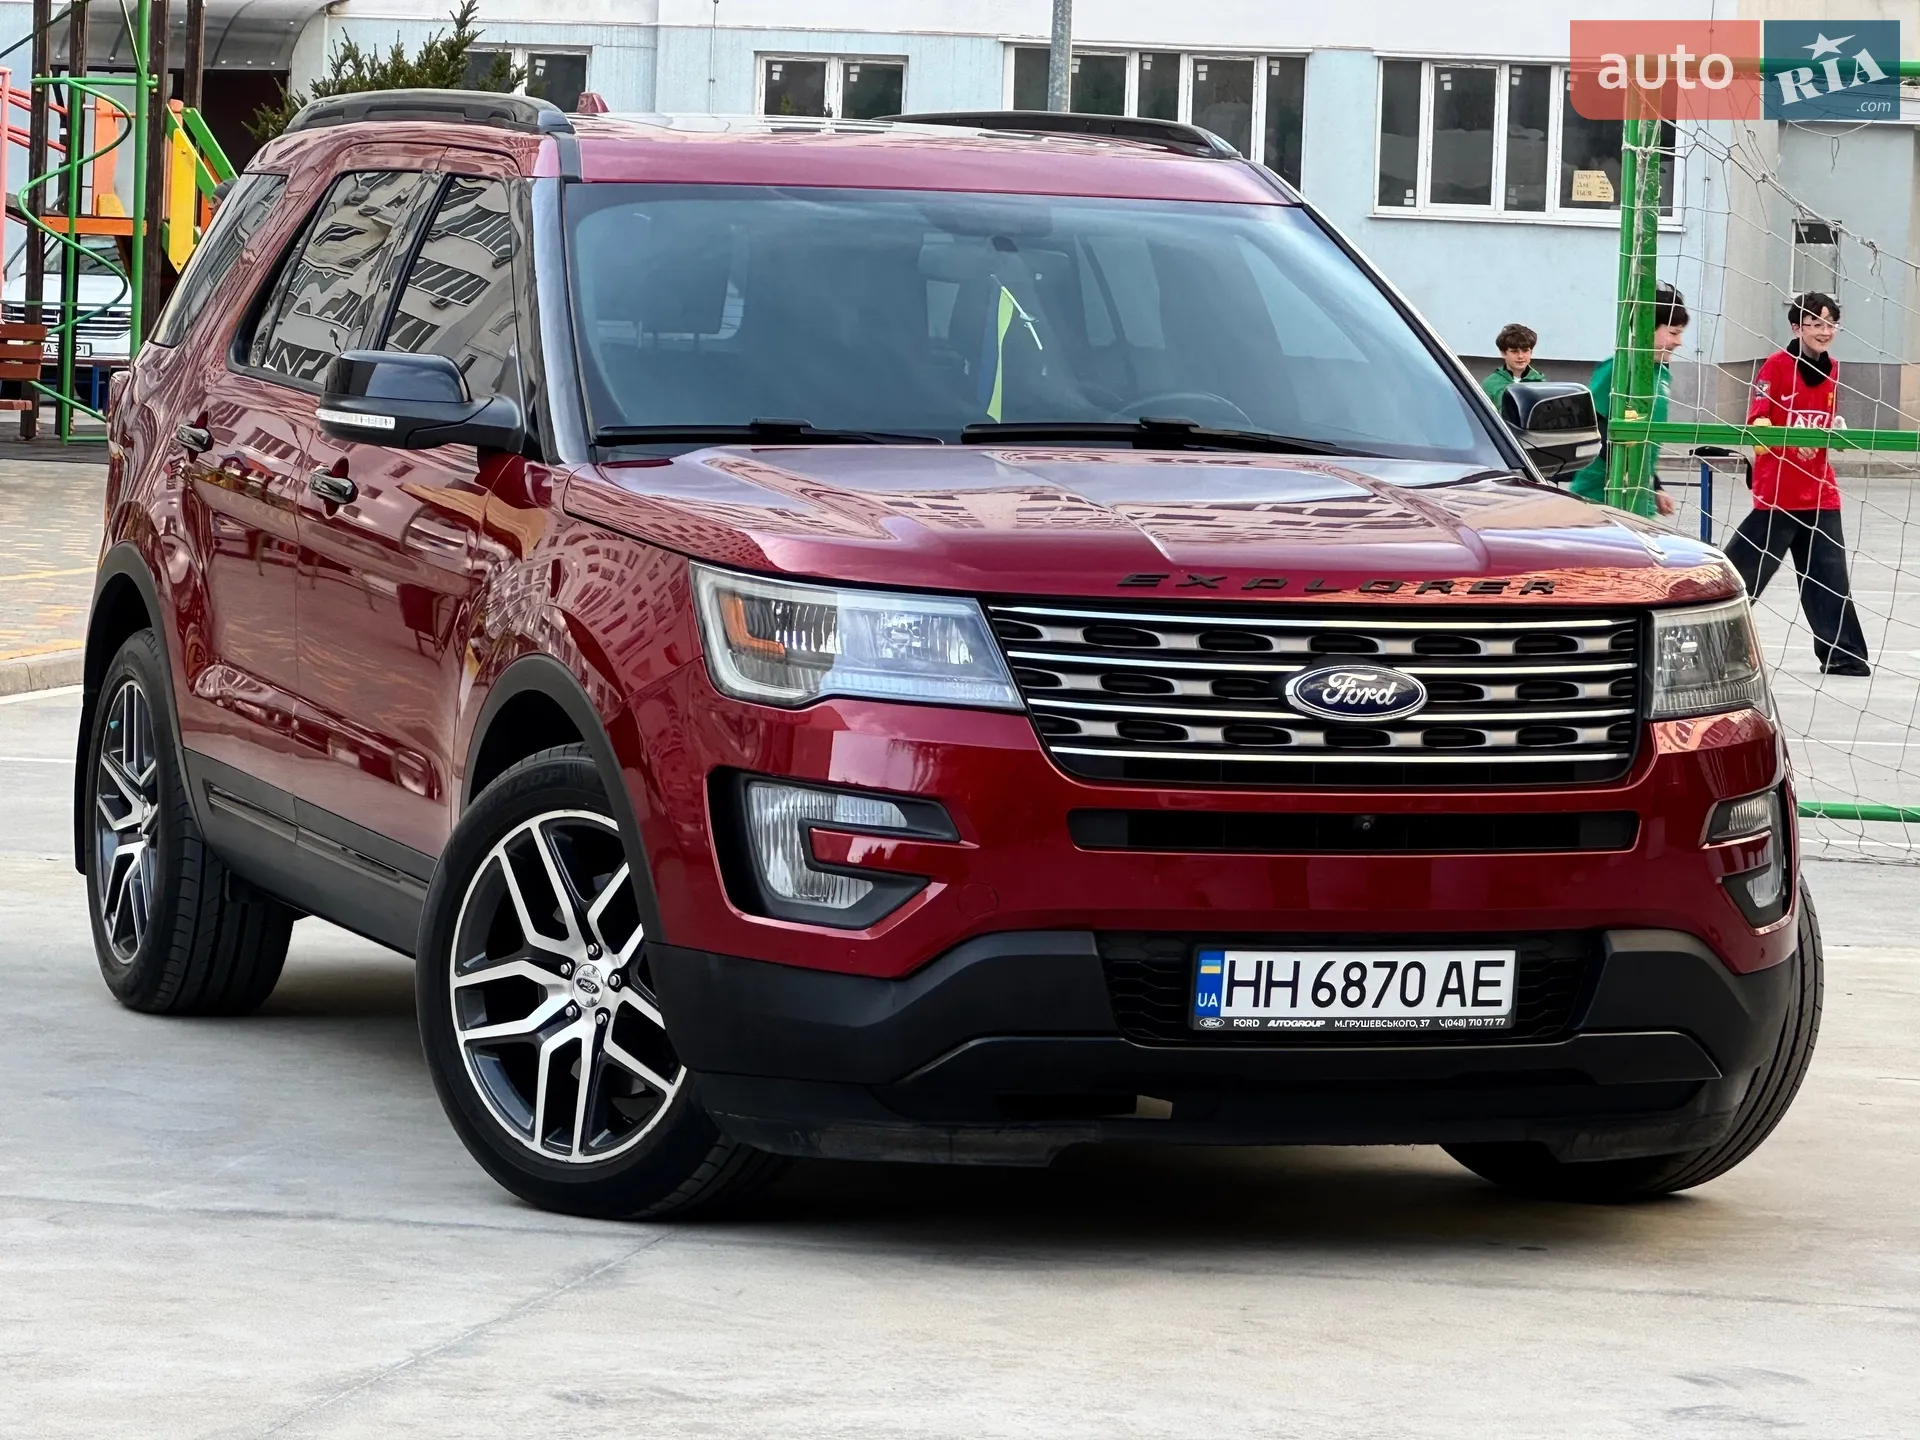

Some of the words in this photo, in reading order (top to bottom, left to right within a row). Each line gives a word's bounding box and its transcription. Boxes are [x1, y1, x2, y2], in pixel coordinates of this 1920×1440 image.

[1116, 572, 1556, 595] EXPLORER
[1322, 672, 1398, 706] Ford
[1225, 960, 1301, 1008] HH
[1311, 960, 1427, 1008] 6870
[1436, 960, 1505, 1007] AE
[1197, 992, 1218, 1008] UA
[1233, 1018, 1260, 1027] FORD
[1267, 1019, 1326, 1027] AUTOGROUP
[1419, 1019, 1430, 1027] 37
[1445, 1018, 1467, 1028] (048)
[1468, 1018, 1482, 1027] 710
[1484, 1018, 1495, 1026] 77
[1496, 1017, 1505, 1026] 77
